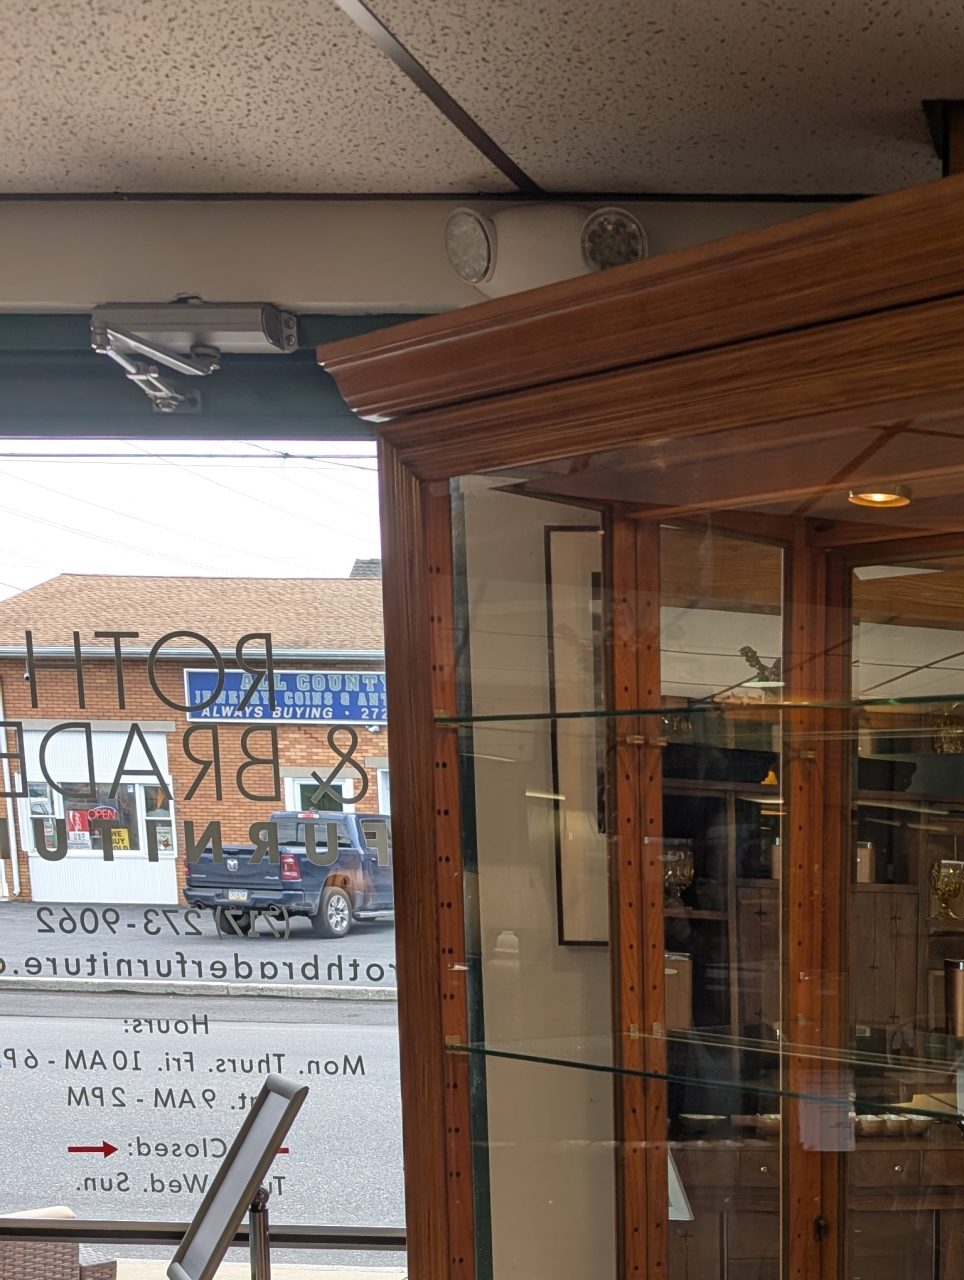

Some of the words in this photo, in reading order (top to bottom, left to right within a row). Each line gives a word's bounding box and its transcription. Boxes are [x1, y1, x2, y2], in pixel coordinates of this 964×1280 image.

[240, 674, 287, 690] ALL
[284, 692, 333, 705] COINS
[201, 705, 264, 718] ALWAYS
[272, 706, 333, 719] BUYING
[89, 809, 117, 821] OPEN
